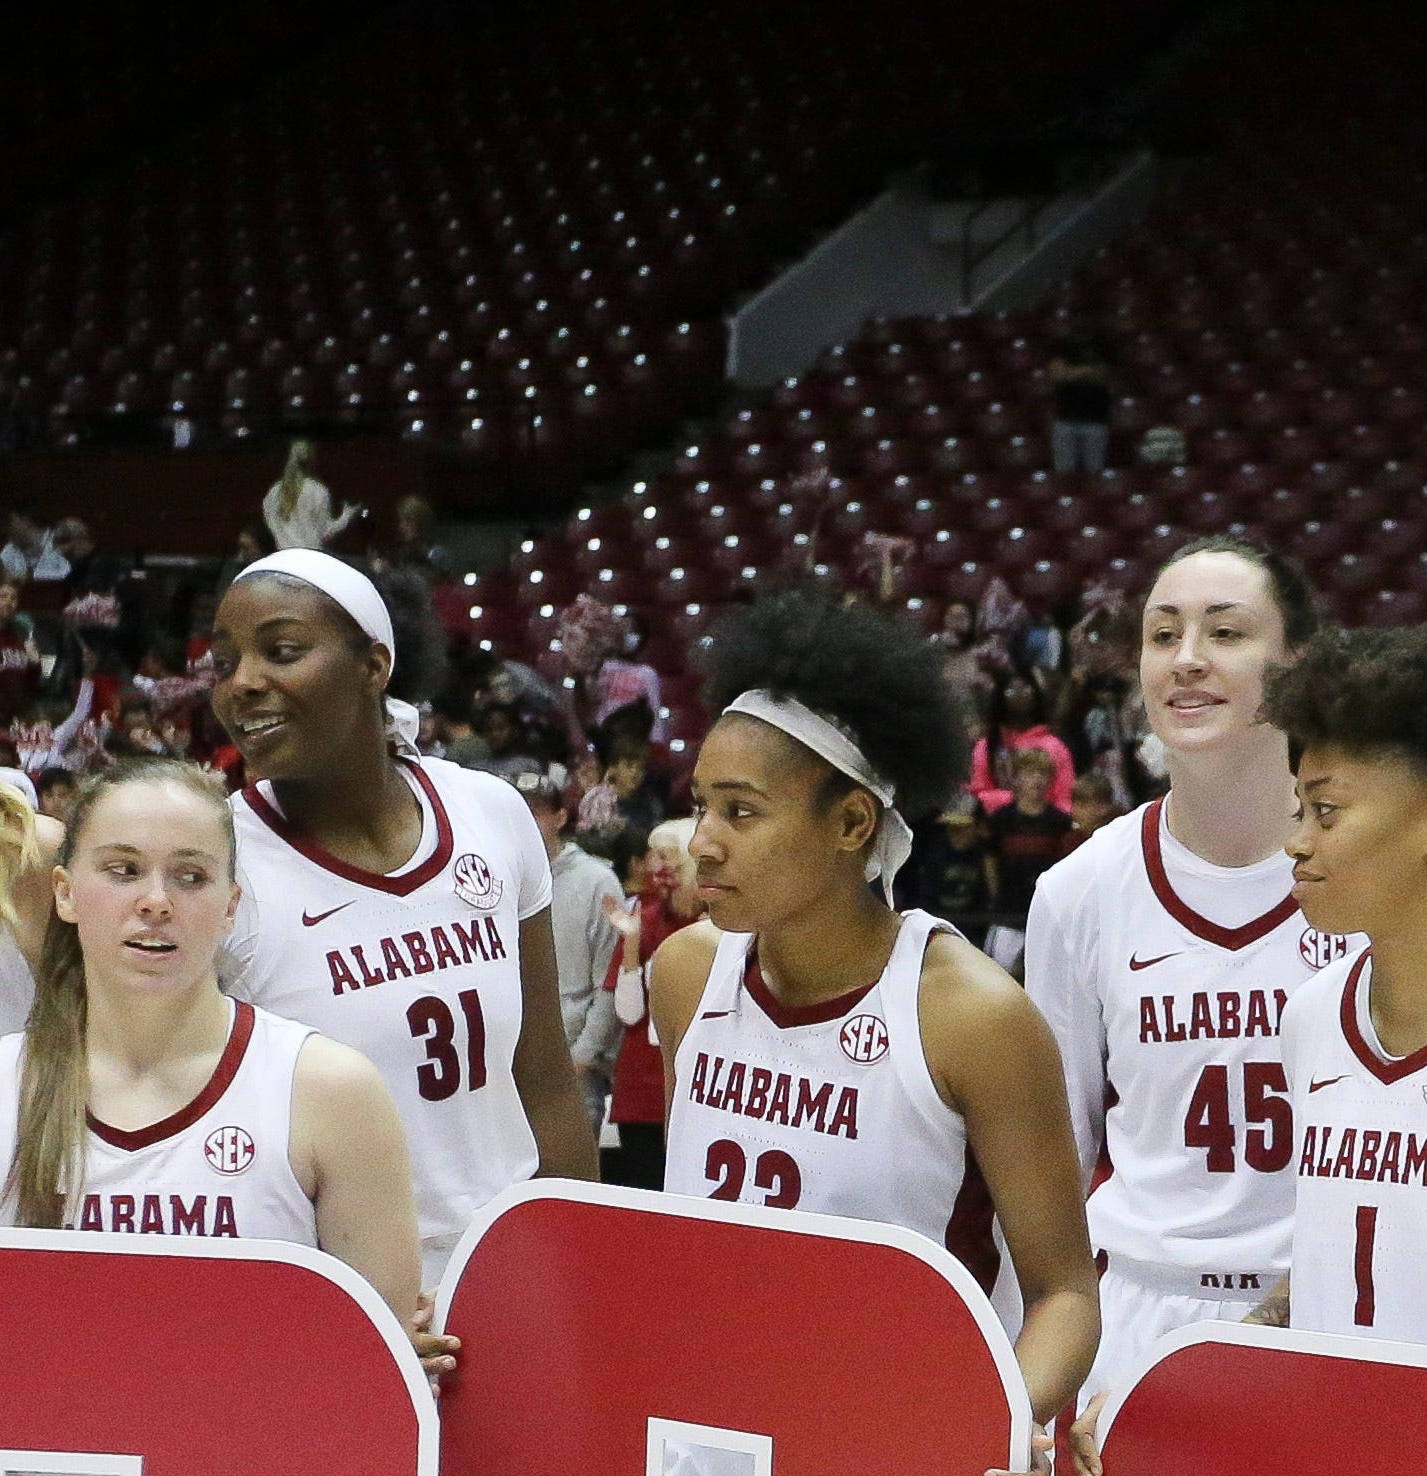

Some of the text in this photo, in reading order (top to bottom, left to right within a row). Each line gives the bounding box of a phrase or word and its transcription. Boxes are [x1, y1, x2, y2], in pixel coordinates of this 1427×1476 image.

[455, 854, 490, 896] SEC
[326, 916, 507, 996] ALABAMA
[406, 988, 487, 1102] 31
[840, 1014, 889, 1062] SEC
[689, 1052, 859, 1140] ALABAMA
[1184, 1062, 1293, 1173] 45
[205, 1126, 254, 1172] SEC
[65, 1194, 240, 1238] ABAMA
[1354, 1206, 1378, 1326] 1
